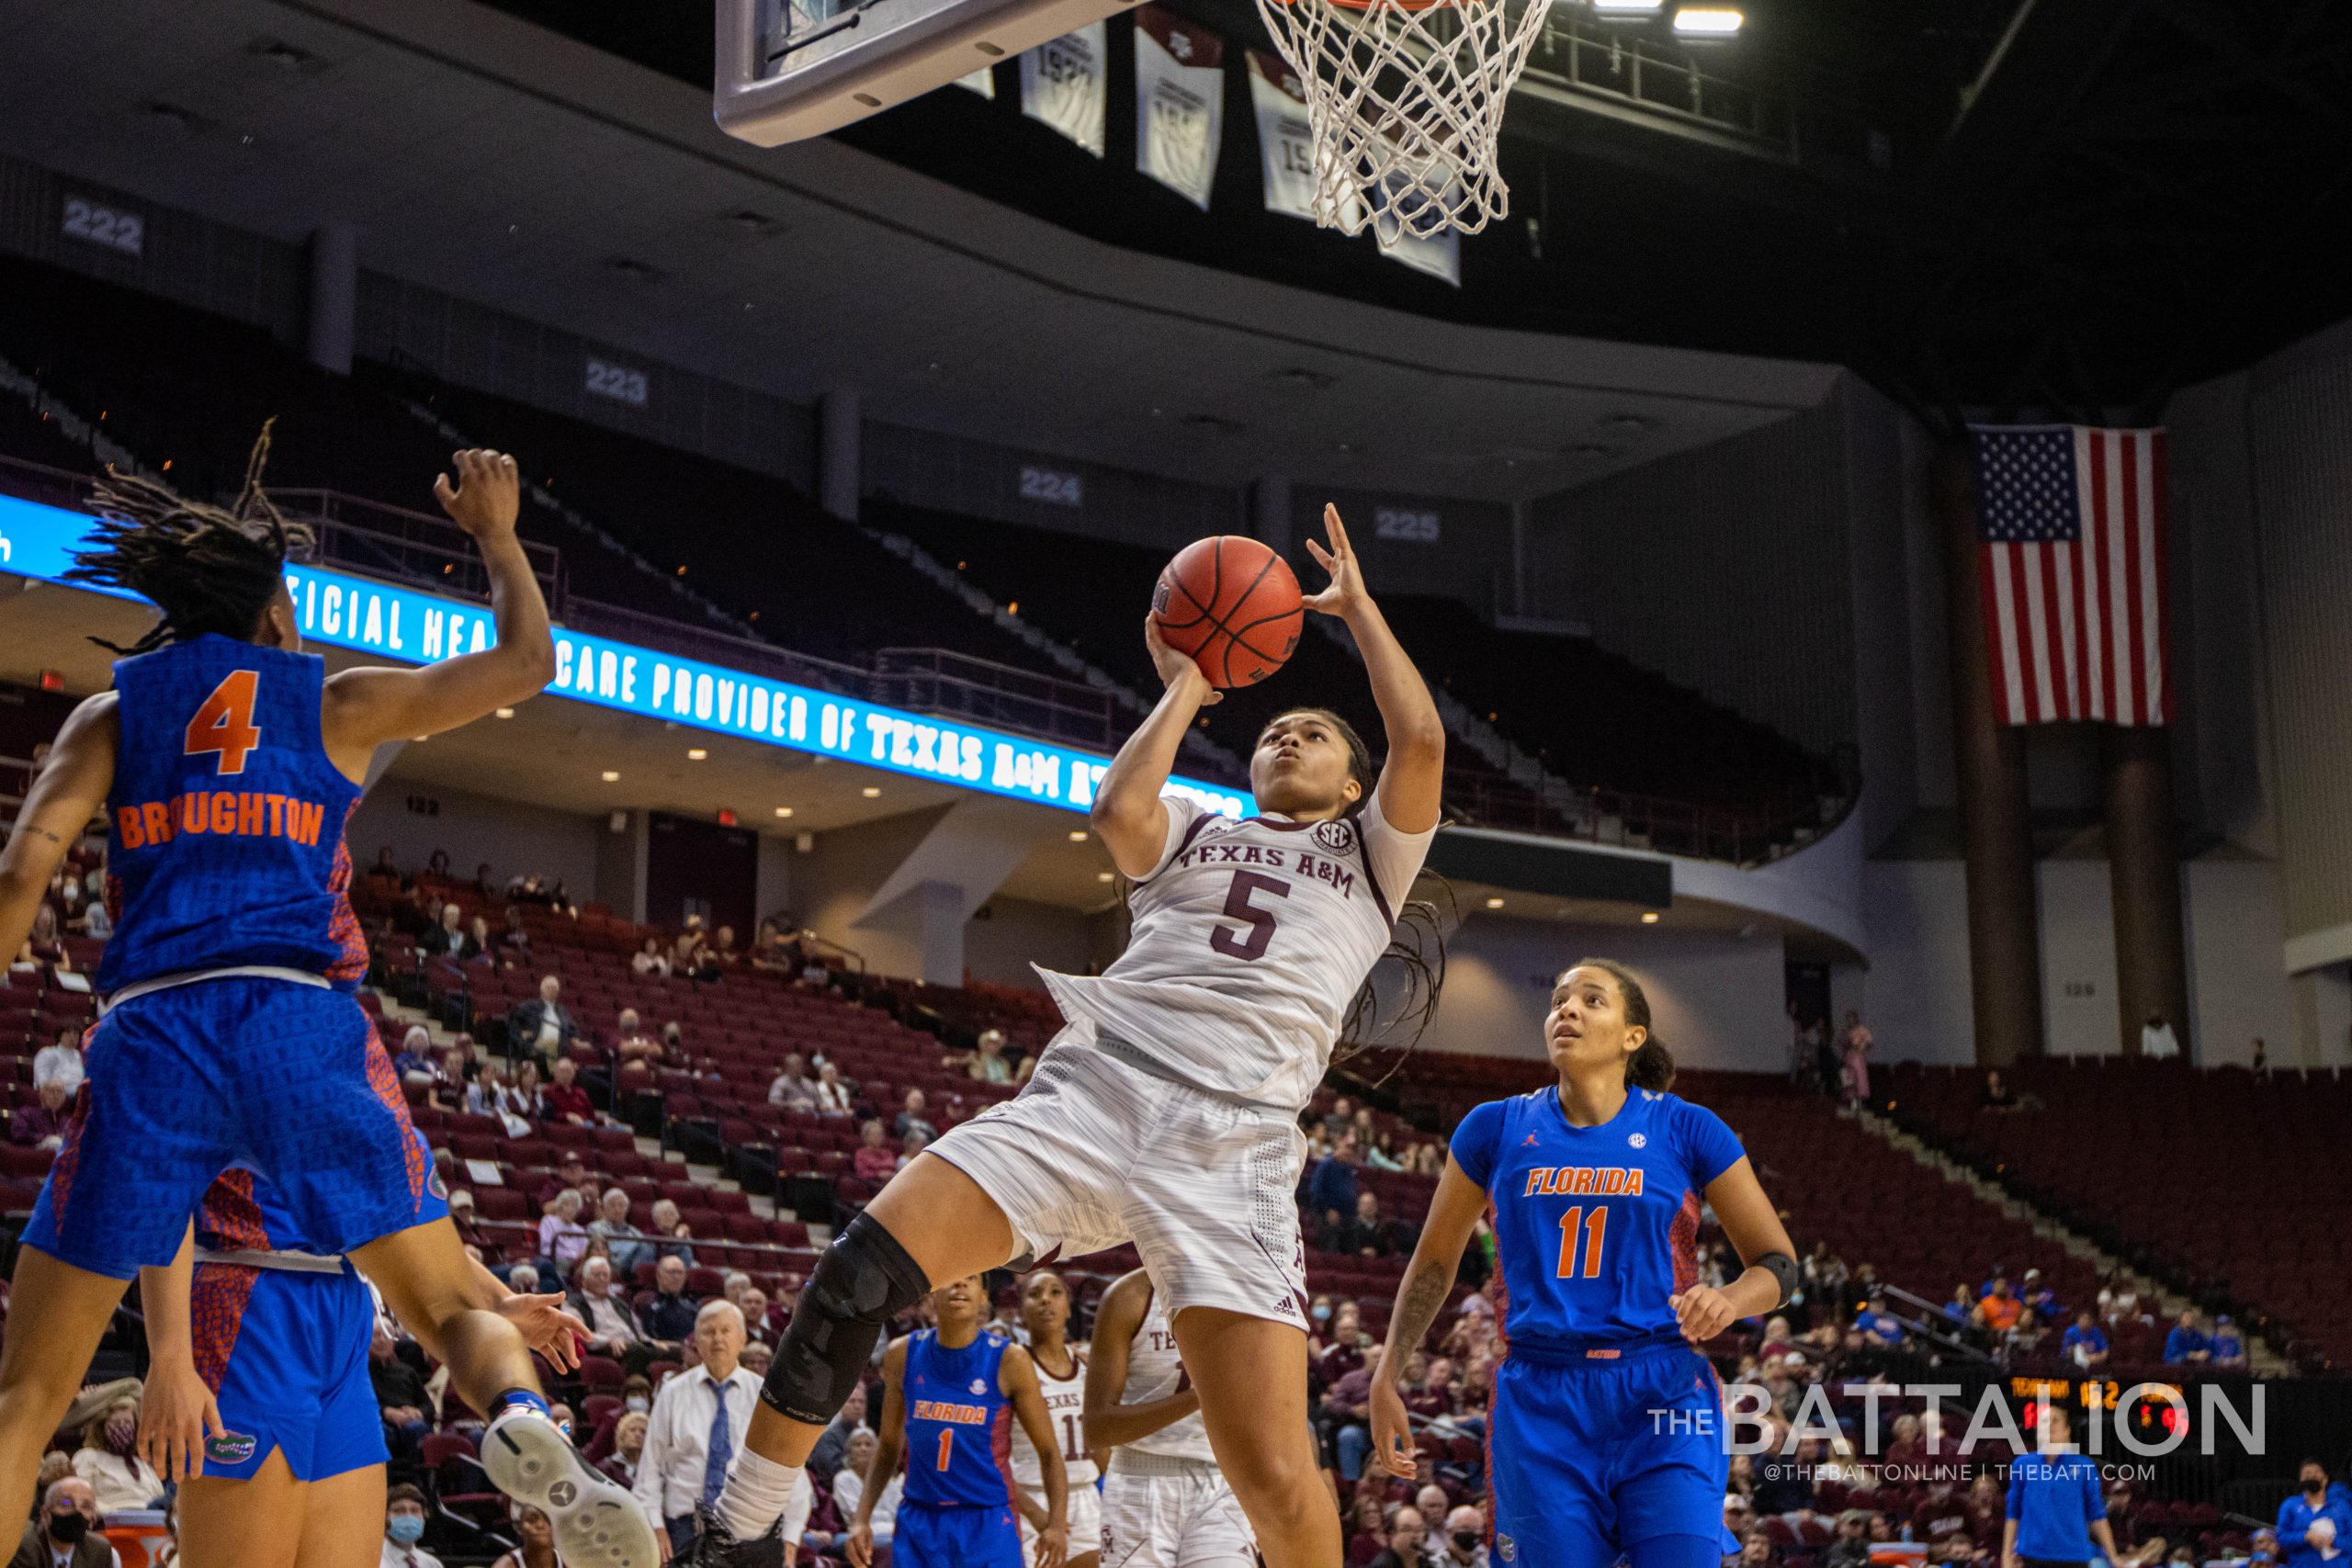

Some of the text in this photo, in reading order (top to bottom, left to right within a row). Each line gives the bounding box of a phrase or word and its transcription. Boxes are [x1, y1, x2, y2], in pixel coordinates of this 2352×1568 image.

[64, 201, 142, 254] 222
[587, 362, 646, 403] 223
[184, 670, 261, 775] 4
[652, 663, 808, 742] PROVIDER
[820, 704, 856, 752] OF
[866, 714, 983, 781] TEXAS
[991, 743, 1060, 798] A&M
[119, 791, 324, 850] BROUGHTON
[1319, 823, 1349, 848] SEC
[1181, 845, 1355, 899] TEXAS A&M
[1210, 869, 1291, 961] 5
[1522, 1167, 1644, 1197] FLORIDA
[1556, 1206, 1608, 1279] 11
[1273, 1306, 1296, 1317] adidas
[913, 1400, 988, 1426] FLORIDA
[1045, 1393, 1080, 1409] EXAS
[937, 1427, 955, 1472] 1
